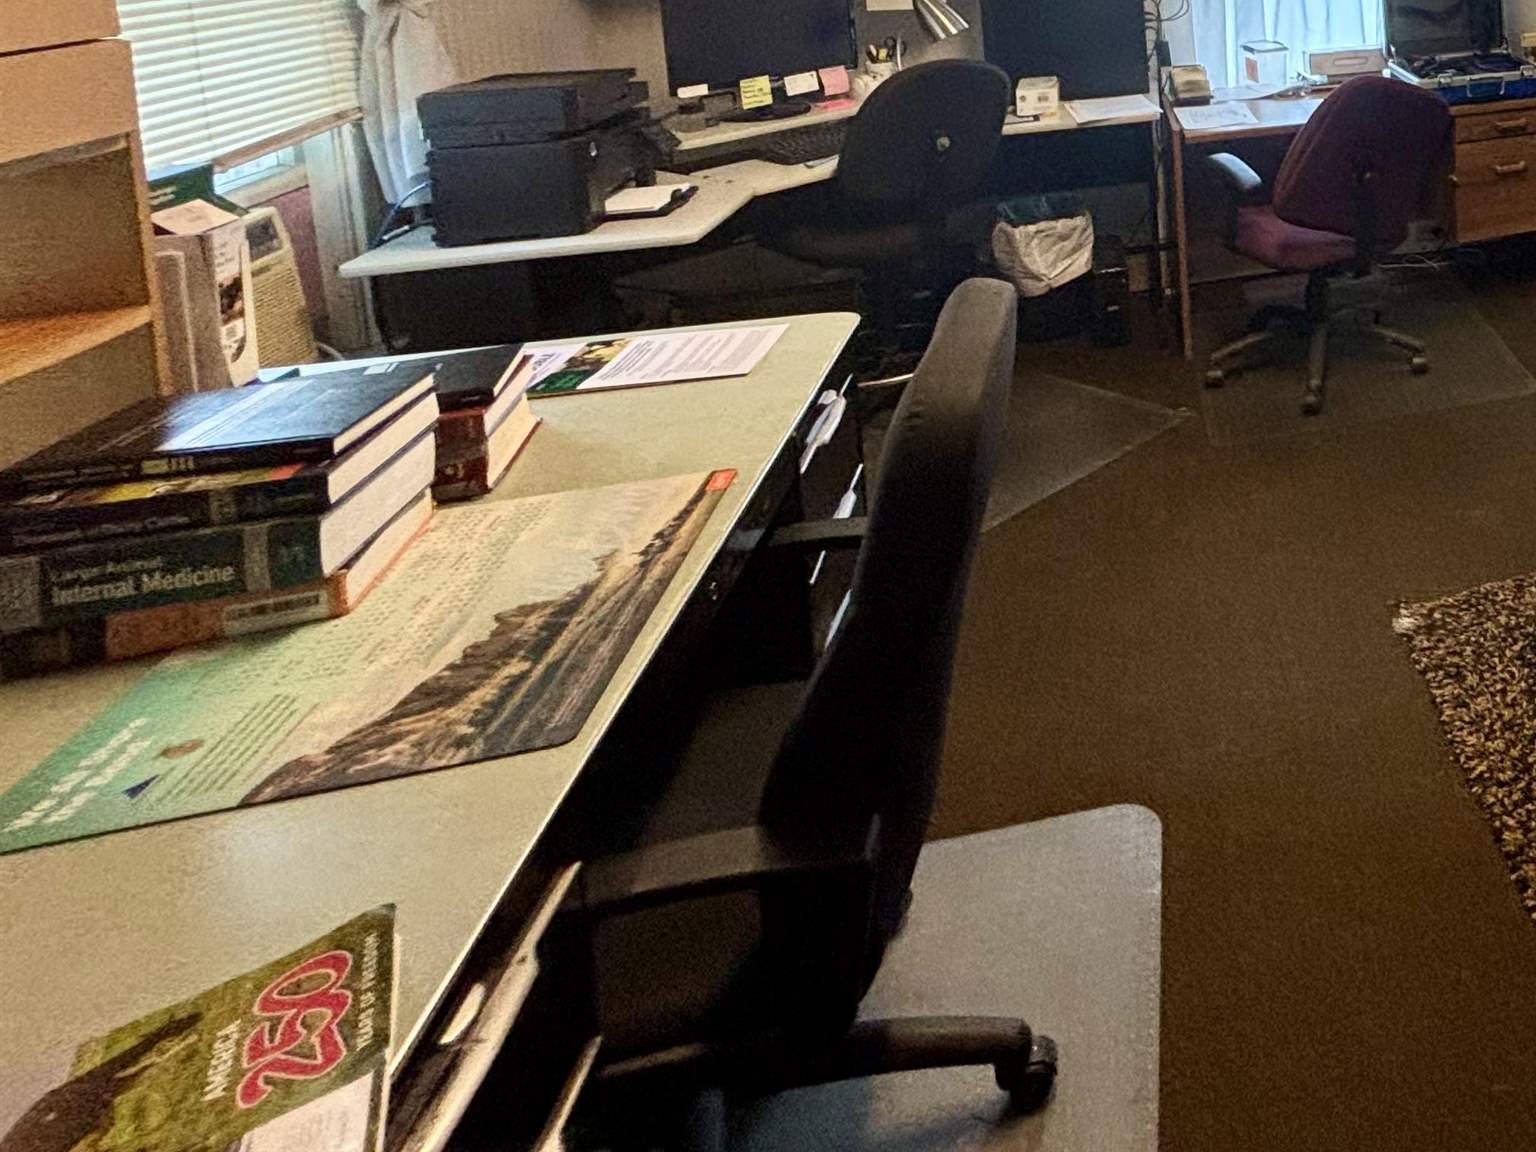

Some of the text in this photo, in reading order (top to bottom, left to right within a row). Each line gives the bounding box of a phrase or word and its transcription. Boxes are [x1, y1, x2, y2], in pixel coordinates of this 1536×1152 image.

[52, 565, 236, 606] Internal Medicine
[236, 949, 353, 1109] 250
